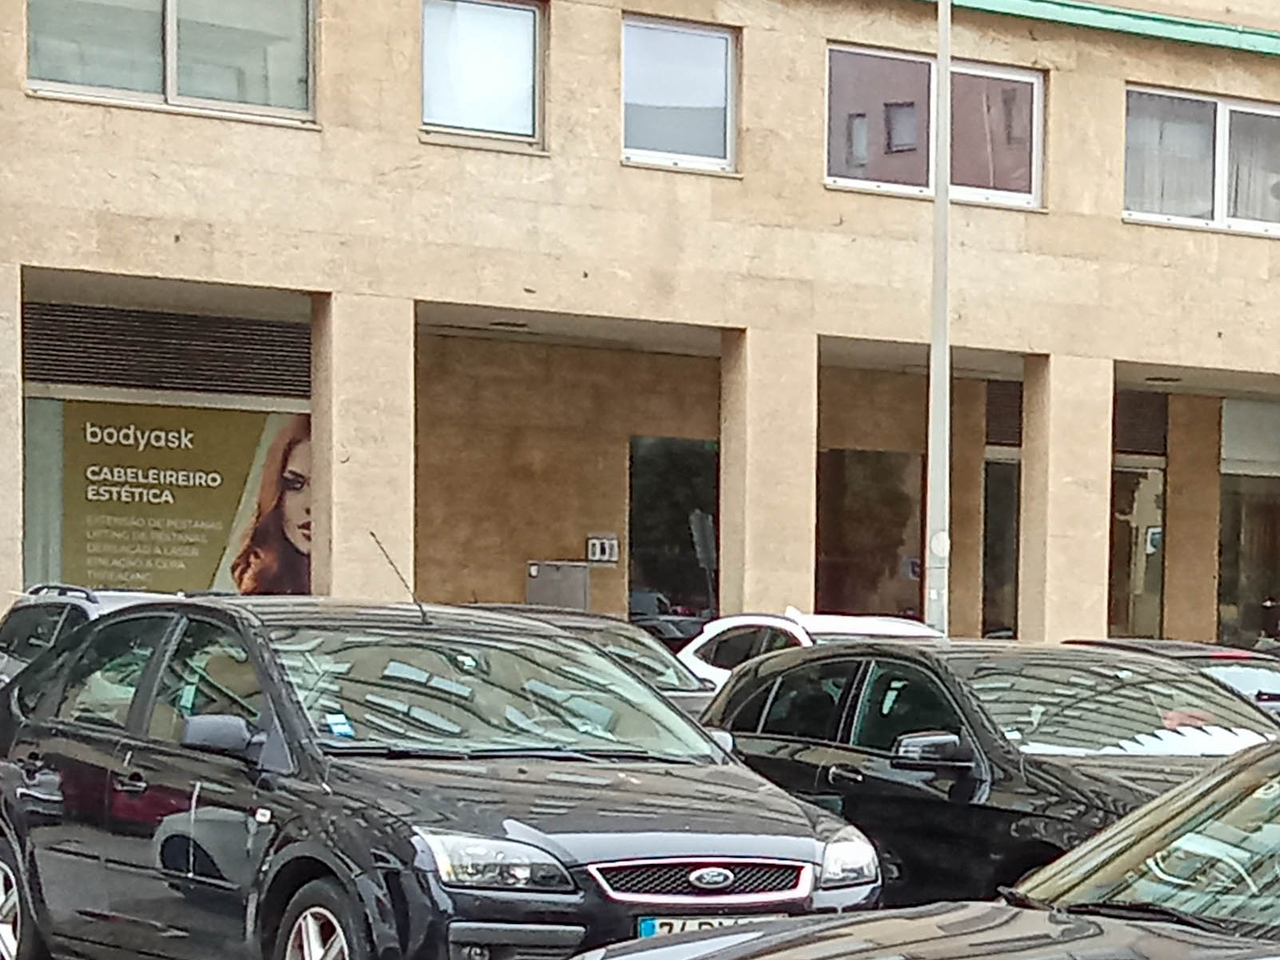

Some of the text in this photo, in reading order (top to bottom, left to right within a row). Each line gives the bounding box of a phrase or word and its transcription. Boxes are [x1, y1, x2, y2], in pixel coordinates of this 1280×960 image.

[84, 422, 194, 451] bodyask
[86, 465, 222, 487] CABELEIREIRO
[86, 484, 174, 504] ESTÉTICA
